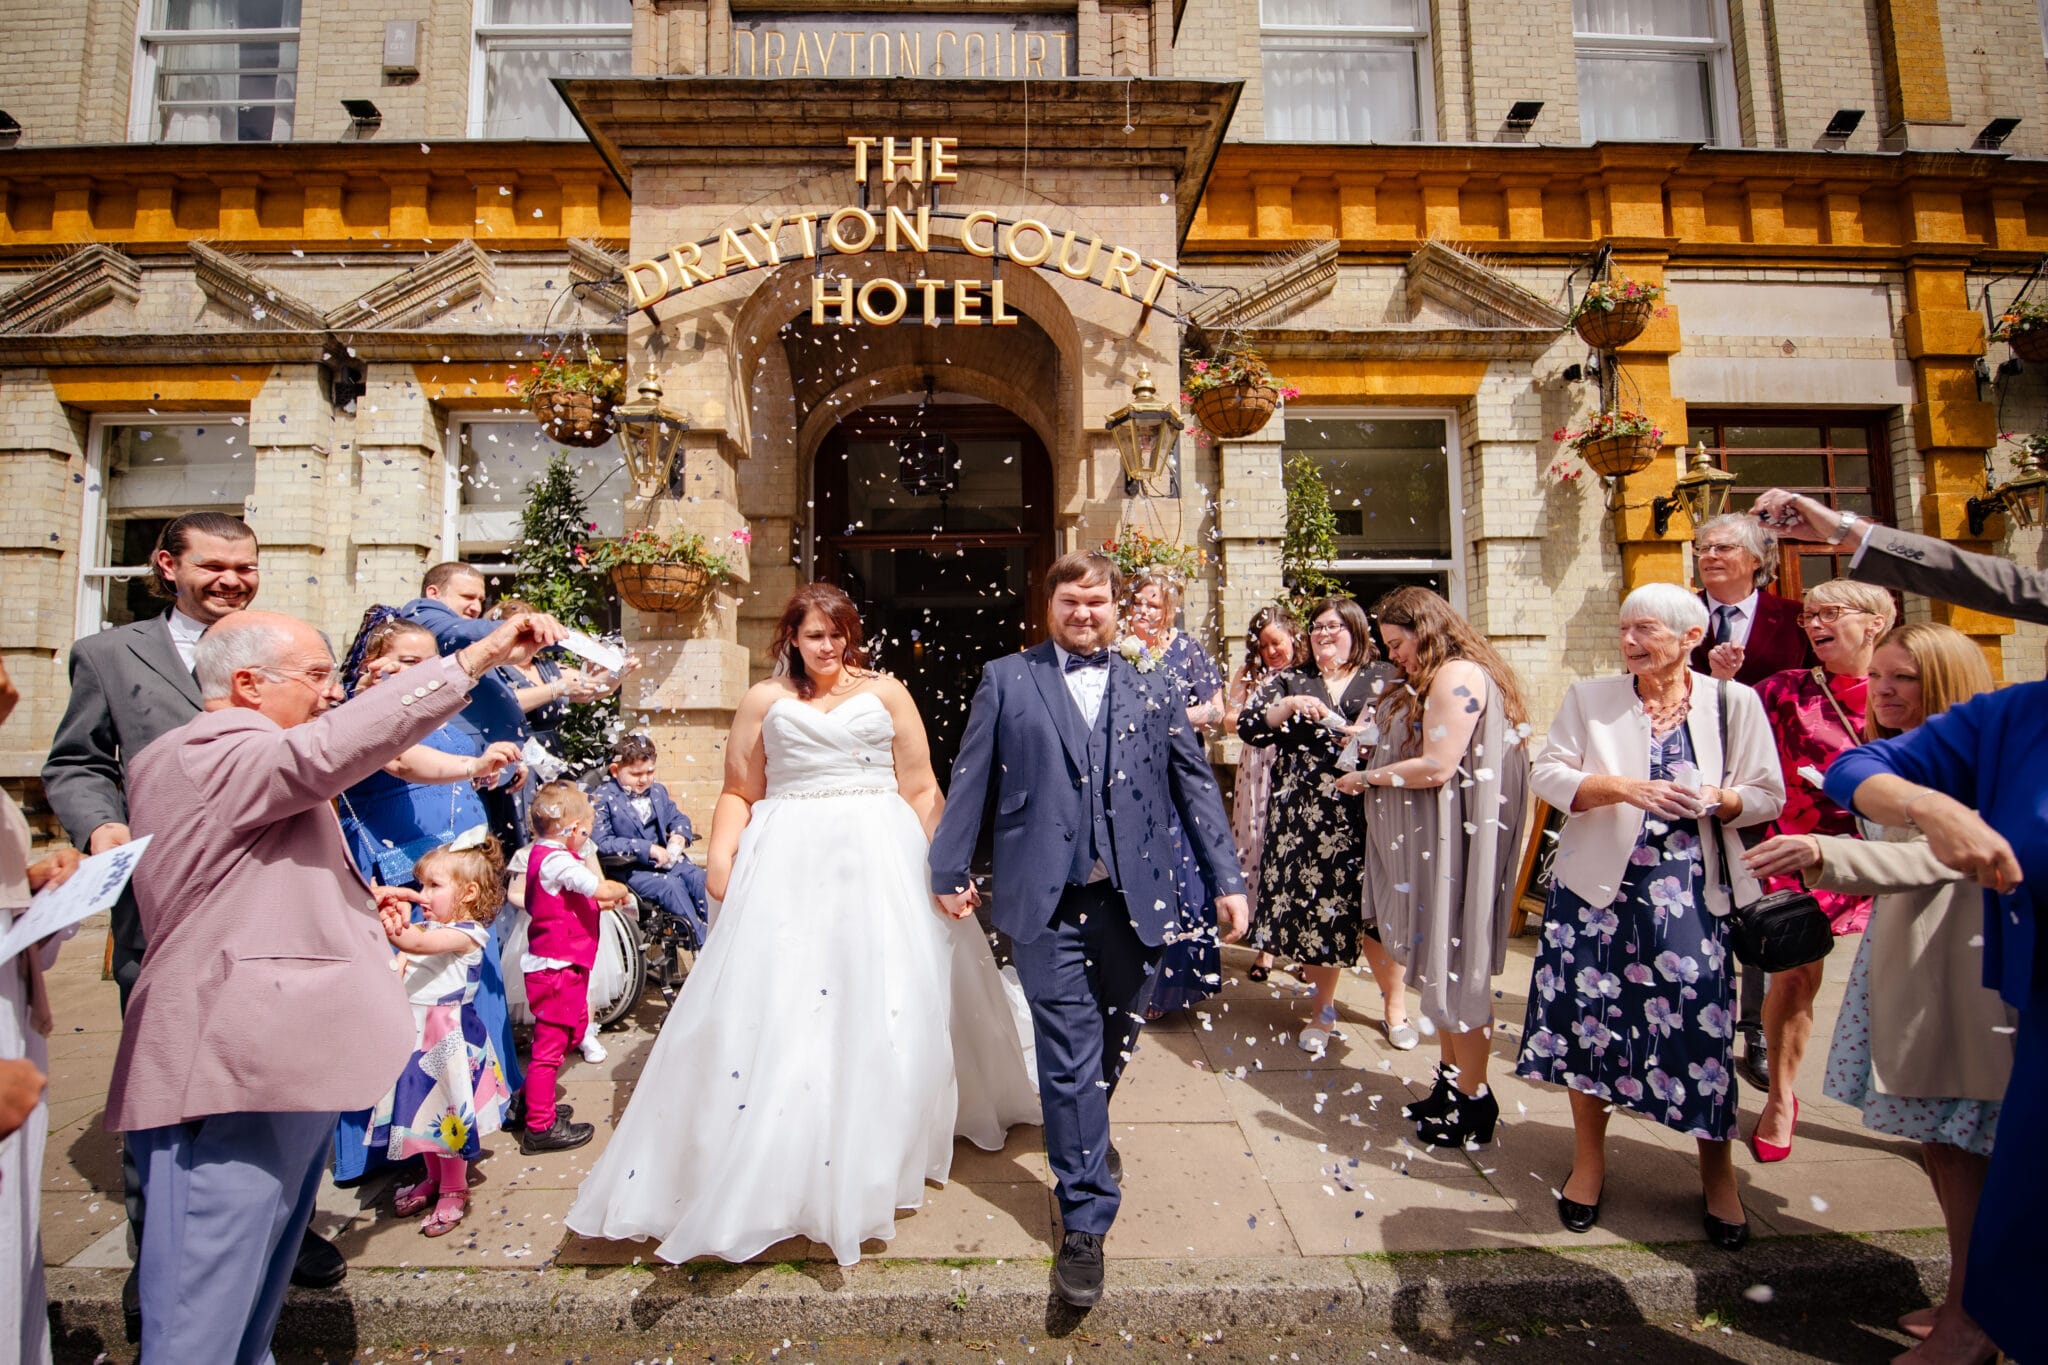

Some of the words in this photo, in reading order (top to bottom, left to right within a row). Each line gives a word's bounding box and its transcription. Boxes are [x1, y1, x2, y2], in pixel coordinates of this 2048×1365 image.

[735, 29, 921, 76] DRAYTON
[936, 30, 1073, 77] COURT
[847, 136, 959, 184] THE
[623, 206, 930, 309] DRAYTON
[961, 210, 1179, 307] COURT
[811, 277, 1018, 326] HOTEL
